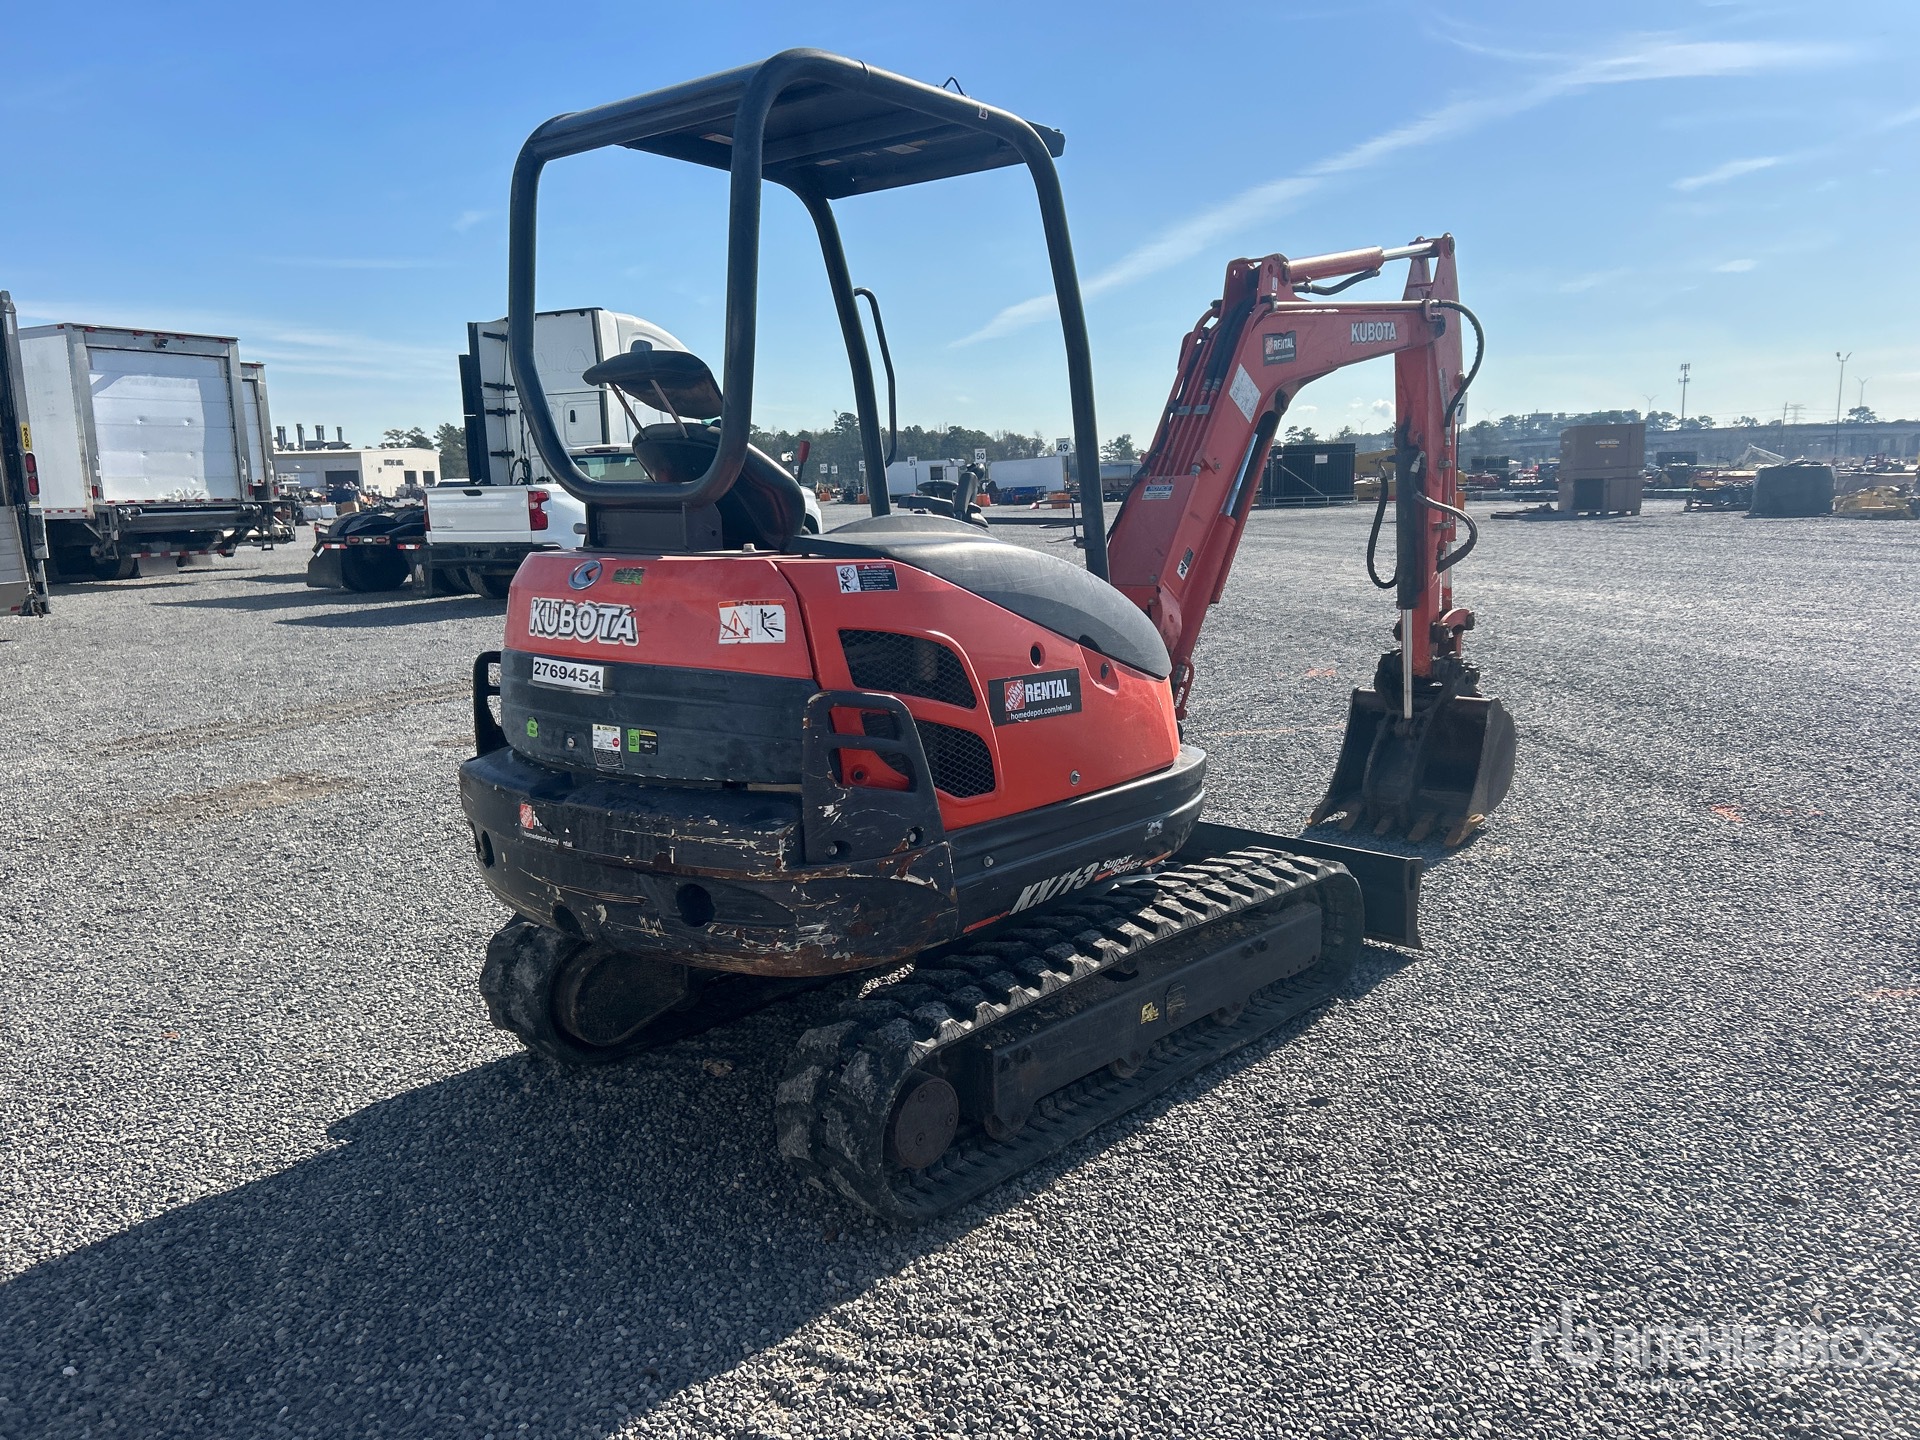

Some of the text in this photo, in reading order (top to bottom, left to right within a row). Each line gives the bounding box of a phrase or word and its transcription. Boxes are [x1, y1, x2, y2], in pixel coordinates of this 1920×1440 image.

[1350, 321, 1398, 342] KUBOTA
[976, 452, 985, 460] 50
[1057, 443, 1069, 452] 49
[529, 597, 639, 646] KUBOTA
[534, 661, 601, 685] 2769454
[1025, 679, 1071, 703] RENTAL
[1010, 703, 1073, 720] homedepot.com/rental
[1100, 854, 1134, 872] Super
[1111, 859, 1143, 876] Series
